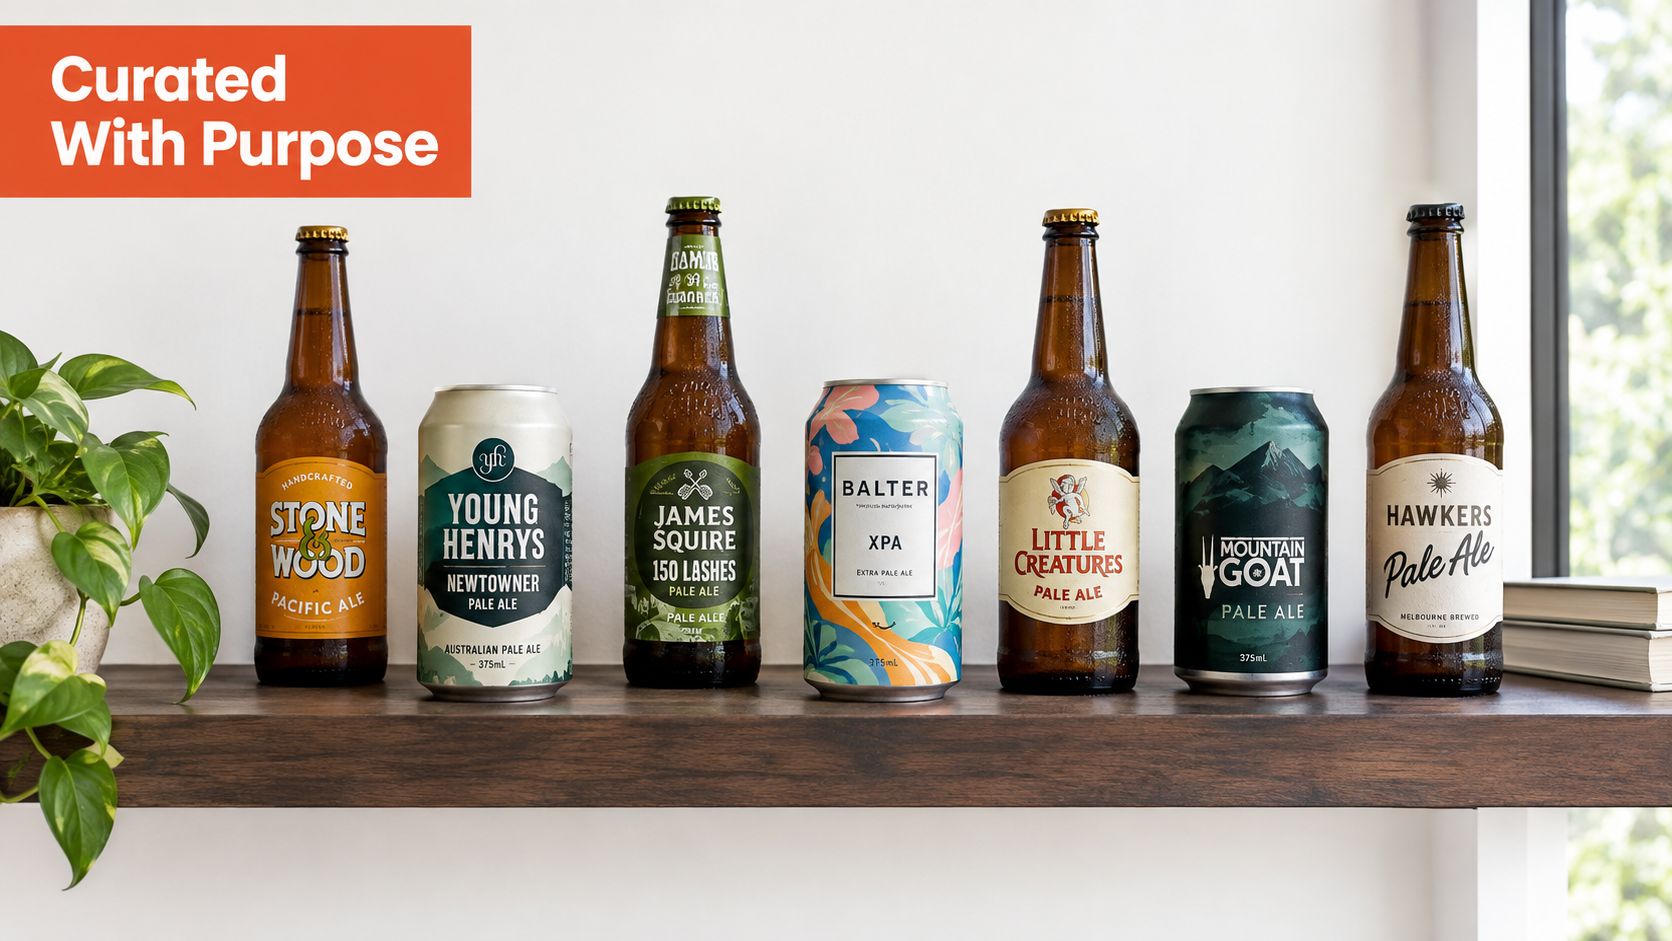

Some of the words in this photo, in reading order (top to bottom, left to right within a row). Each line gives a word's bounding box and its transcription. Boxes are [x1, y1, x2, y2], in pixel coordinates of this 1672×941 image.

[281, 472, 353, 491] HANDCRAFTED
[842, 480, 929, 497] BALTER
[270, 501, 367, 537] STONE
[447, 493, 539, 525] YOUNG
[653, 505, 734, 529] JAMES
[1387, 504, 1492, 527] HAWKERS
[300, 517, 332, 561] &
[443, 528, 545, 560] HENRYS
[653, 530, 736, 553] SQUIRE
[868, 535, 902, 550] XPA
[1031, 528, 1106, 551] LITTLE
[1220, 540, 1305, 558] MOUNTAIN
[270, 543, 366, 579] WOOD
[652, 559, 679, 581] 150
[683, 559, 736, 582] LASHES
[1014, 550, 1123, 579] CREATURES
[1383, 543, 1446, 599] Pale
[1448, 529, 1495, 576] Ale
[881, 569, 898, 577] PALE
[900, 569, 913, 577] ALE
[1218, 557, 1305, 587] GOAT
[447, 573, 540, 593] NEWTOWNER
[669, 586, 695, 597] PALE
[699, 586, 720, 597] ALE
[1033, 584, 1070, 601] PALE
[1075, 585, 1103, 601] ALE
[271, 591, 332, 615] PACIFIC
[338, 591, 365, 613] ALE
[468, 598, 494, 610] PALE
[497, 598, 517, 610] ALE
[1221, 604, 1267, 620] PALE
[1274, 603, 1304, 620] ALE
[666, 612, 695, 623] PALE
[1400, 613, 1447, 621] MELBOURNE
[1450, 613, 1480, 621] BREWED
[444, 644, 498, 655] AUSTRALIAN
[501, 644, 524, 655] PALE
[526, 644, 541, 654] ALE
[1239, 653, 1268, 662] 375mL
[478, 659, 506, 669] 375mL
